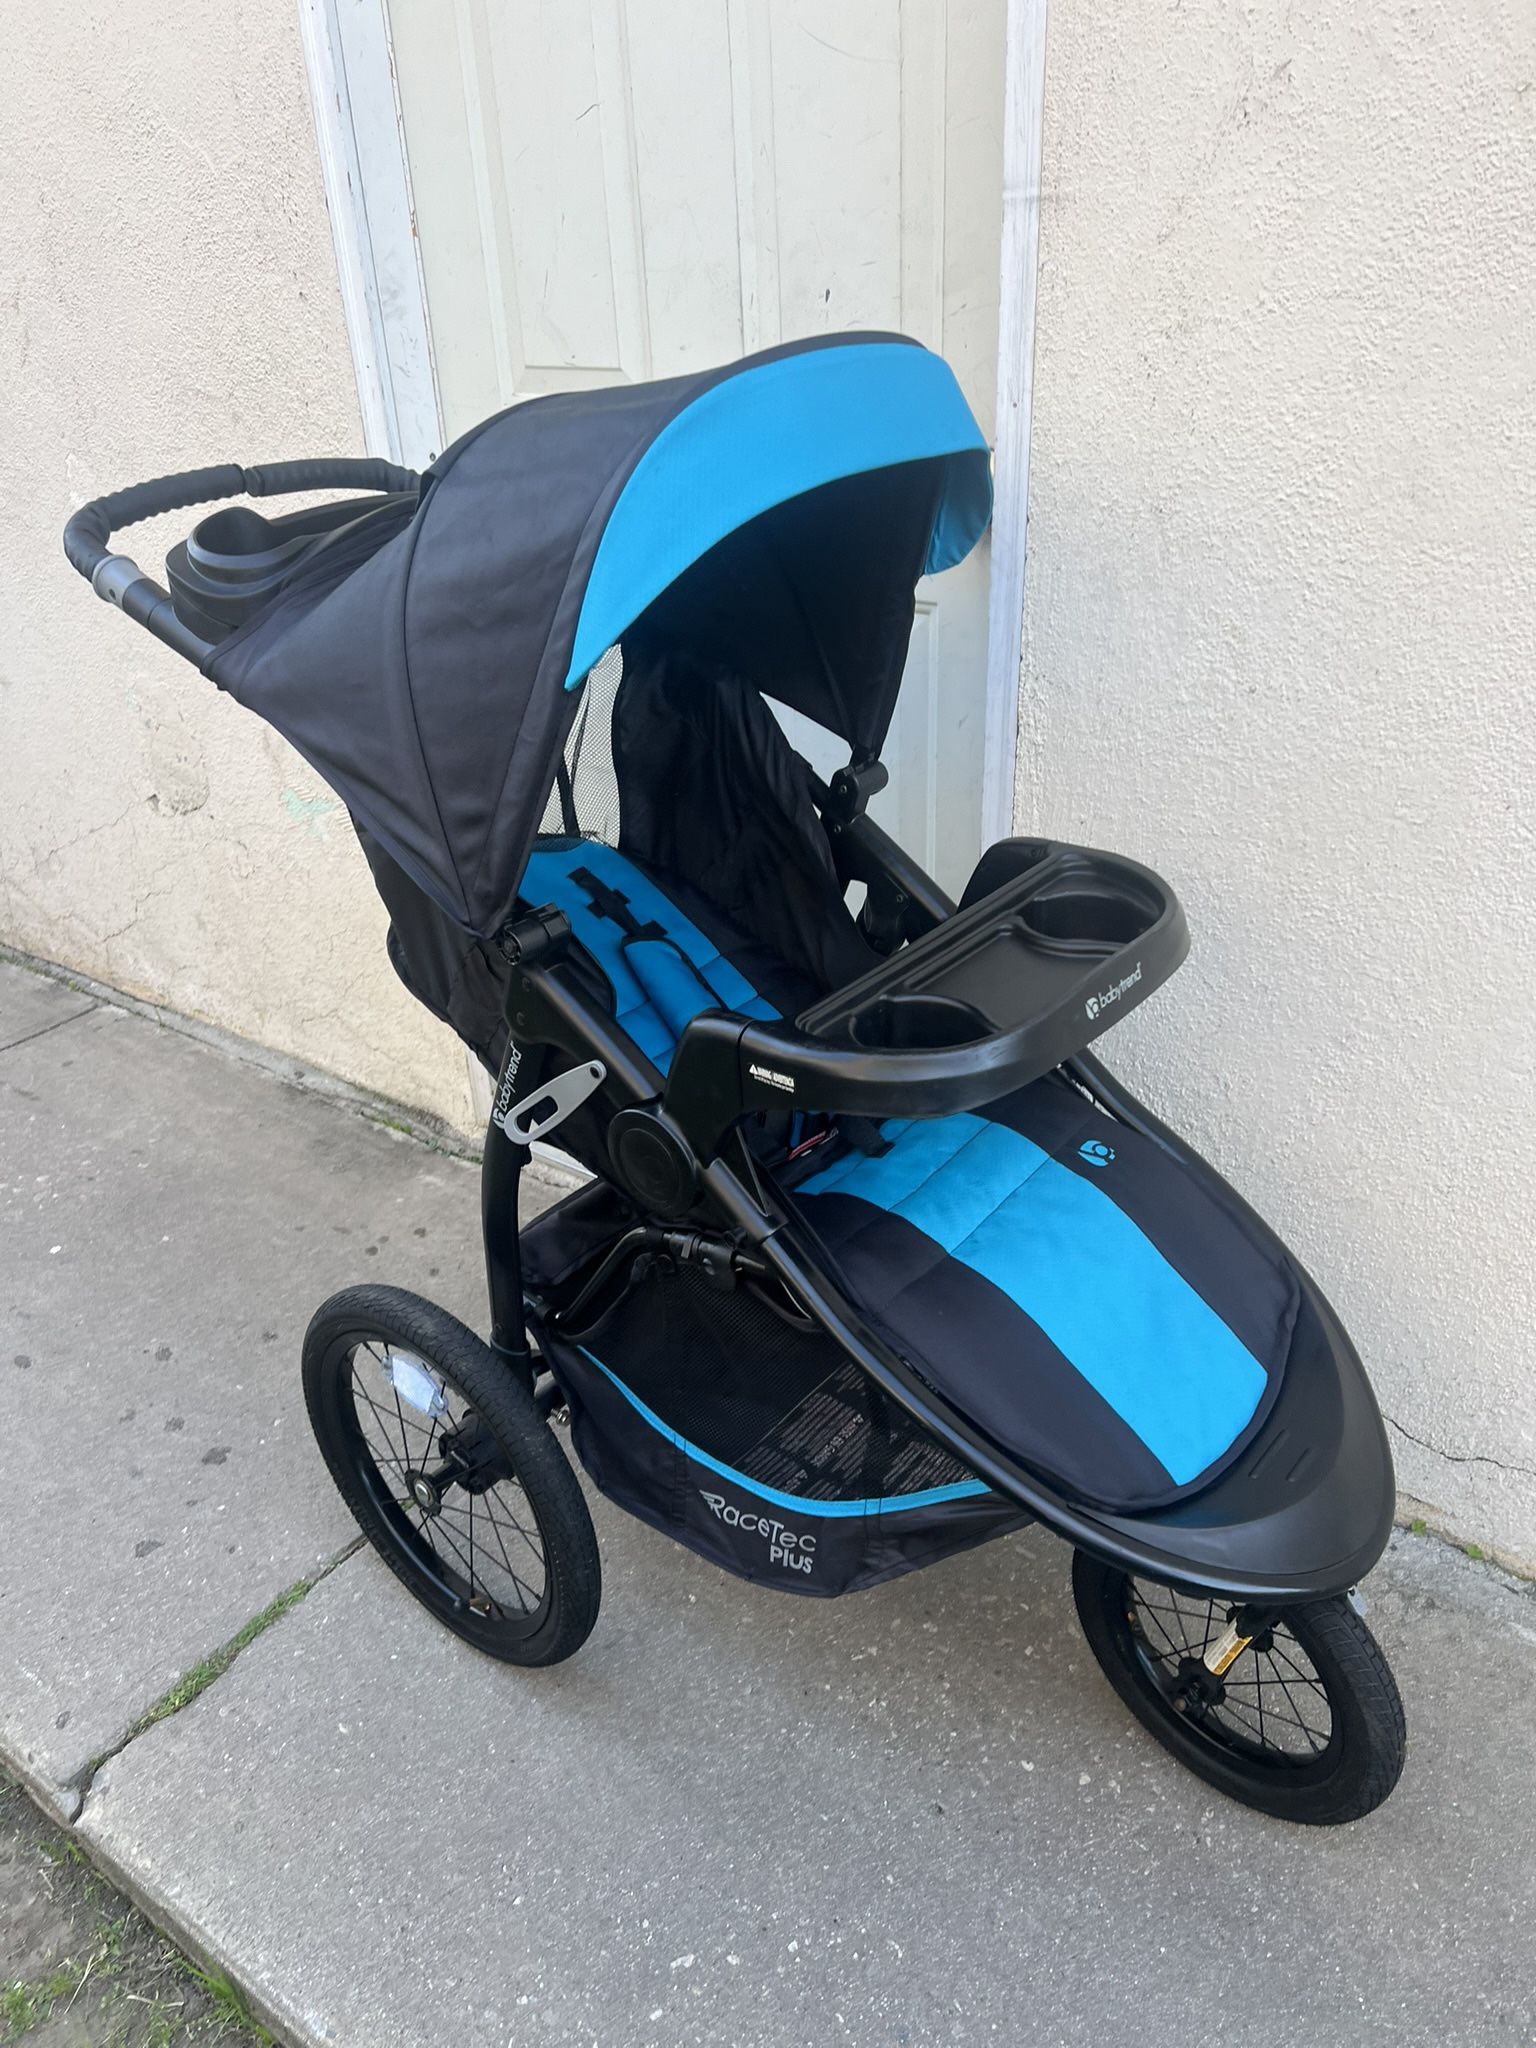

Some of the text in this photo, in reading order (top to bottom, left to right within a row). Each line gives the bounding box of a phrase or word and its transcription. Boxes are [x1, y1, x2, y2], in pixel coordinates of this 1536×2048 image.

[1097, 960, 1142, 1009] babytrend
[495, 1039, 523, 1113] babytrend
[699, 1489, 817, 1552] RaceTec
